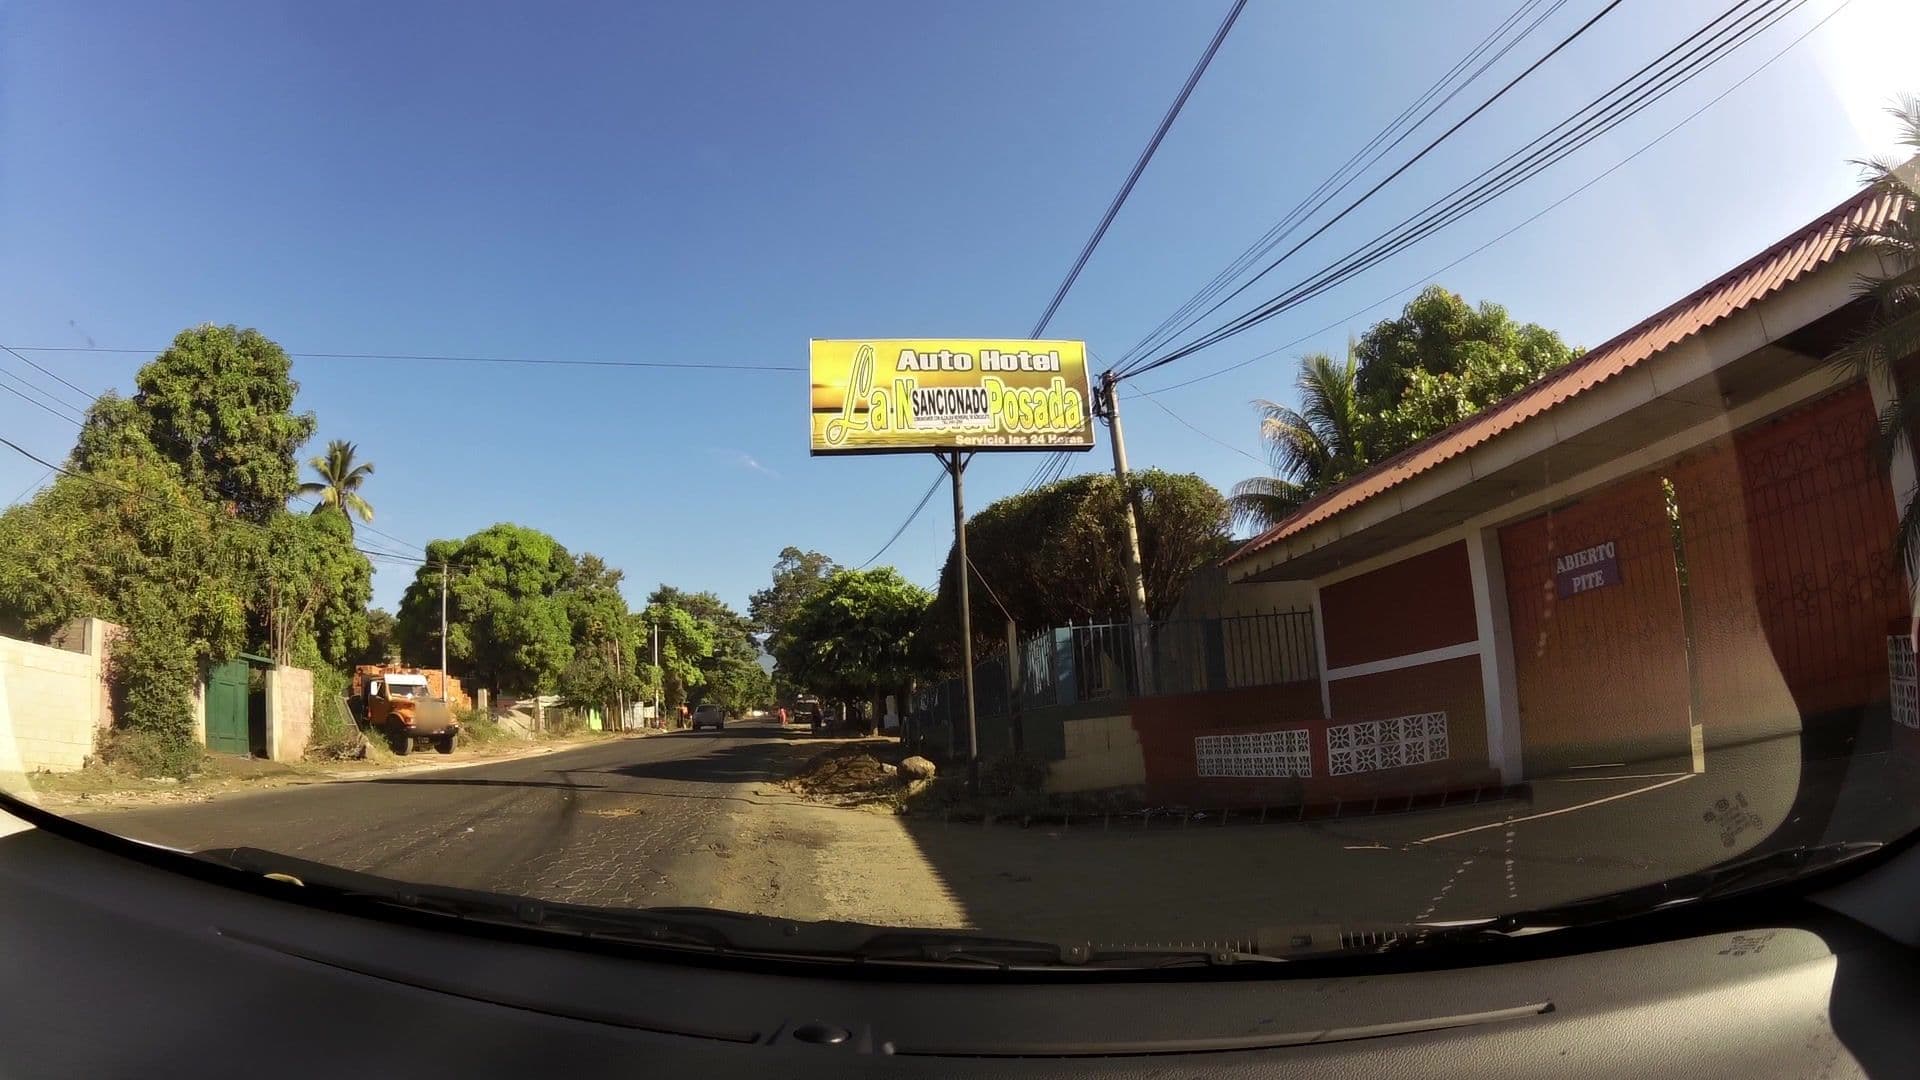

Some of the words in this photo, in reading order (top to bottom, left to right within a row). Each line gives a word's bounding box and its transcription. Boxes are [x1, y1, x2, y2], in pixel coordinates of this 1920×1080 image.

[897, 350, 973, 371] Auto
[980, 350, 1061, 372] Hotel
[826, 344, 888, 446] La
[984, 378, 1082, 431] Posada
[912, 388, 988, 416] SANCIONADO
[955, 435, 1006, 445] Servicio
[1008, 434, 1028, 444] las
[1030, 434, 1046, 444] 24
[1556, 541, 1616, 574] ABIERTO
[1571, 570, 1605, 593] PITE
